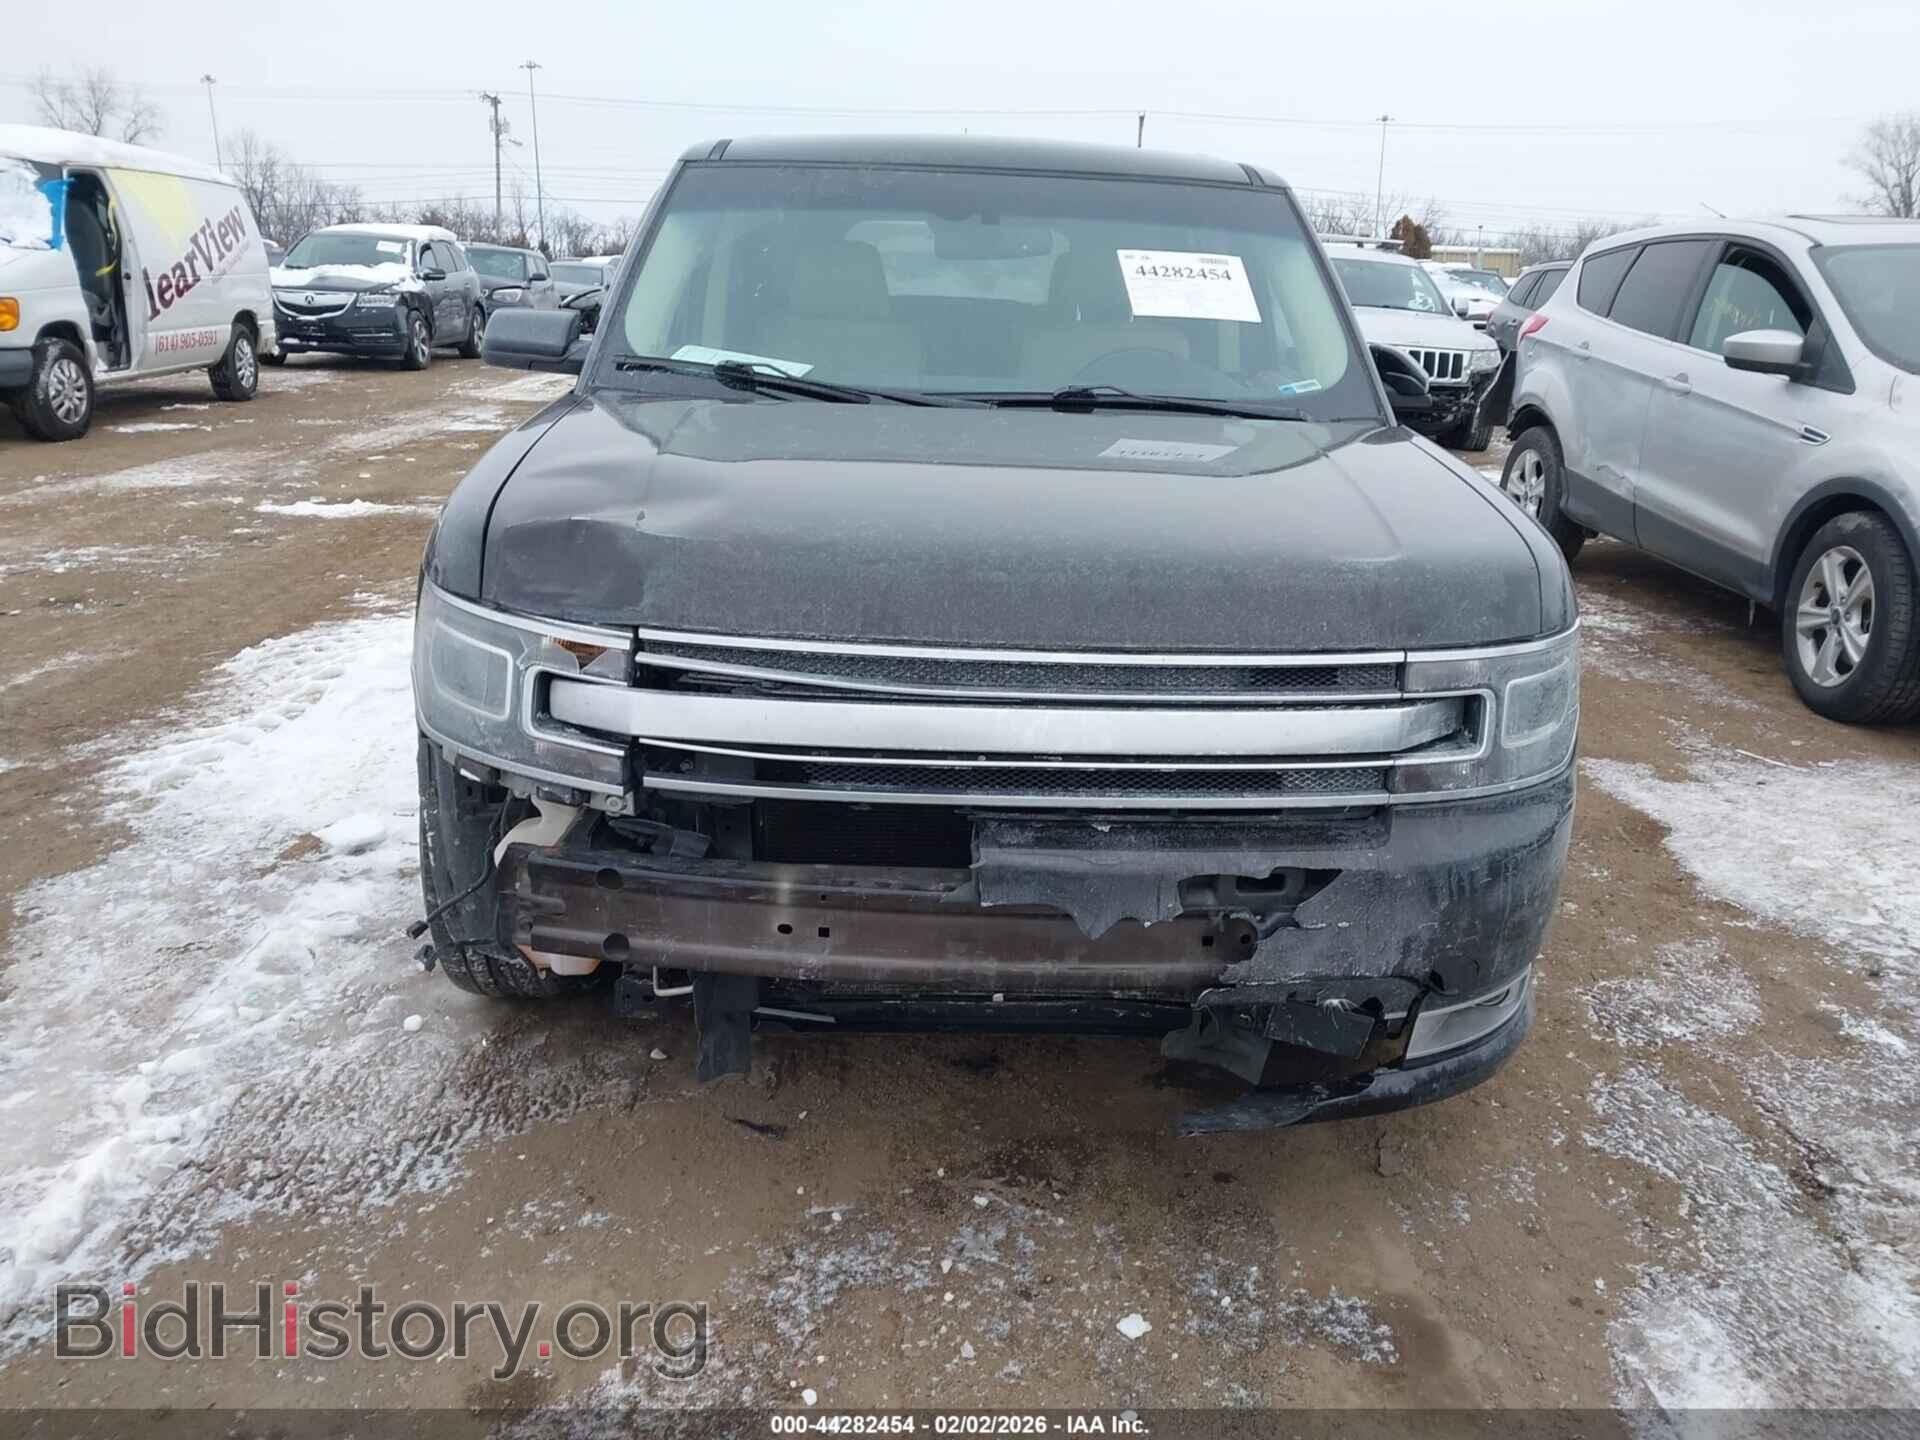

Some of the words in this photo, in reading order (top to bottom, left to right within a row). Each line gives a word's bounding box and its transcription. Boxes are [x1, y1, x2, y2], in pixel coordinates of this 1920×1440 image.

[1135, 265, 1232, 281] 44282454
[155, 335, 178, 355] (614)
[179, 330, 218, 349] 905-0591
